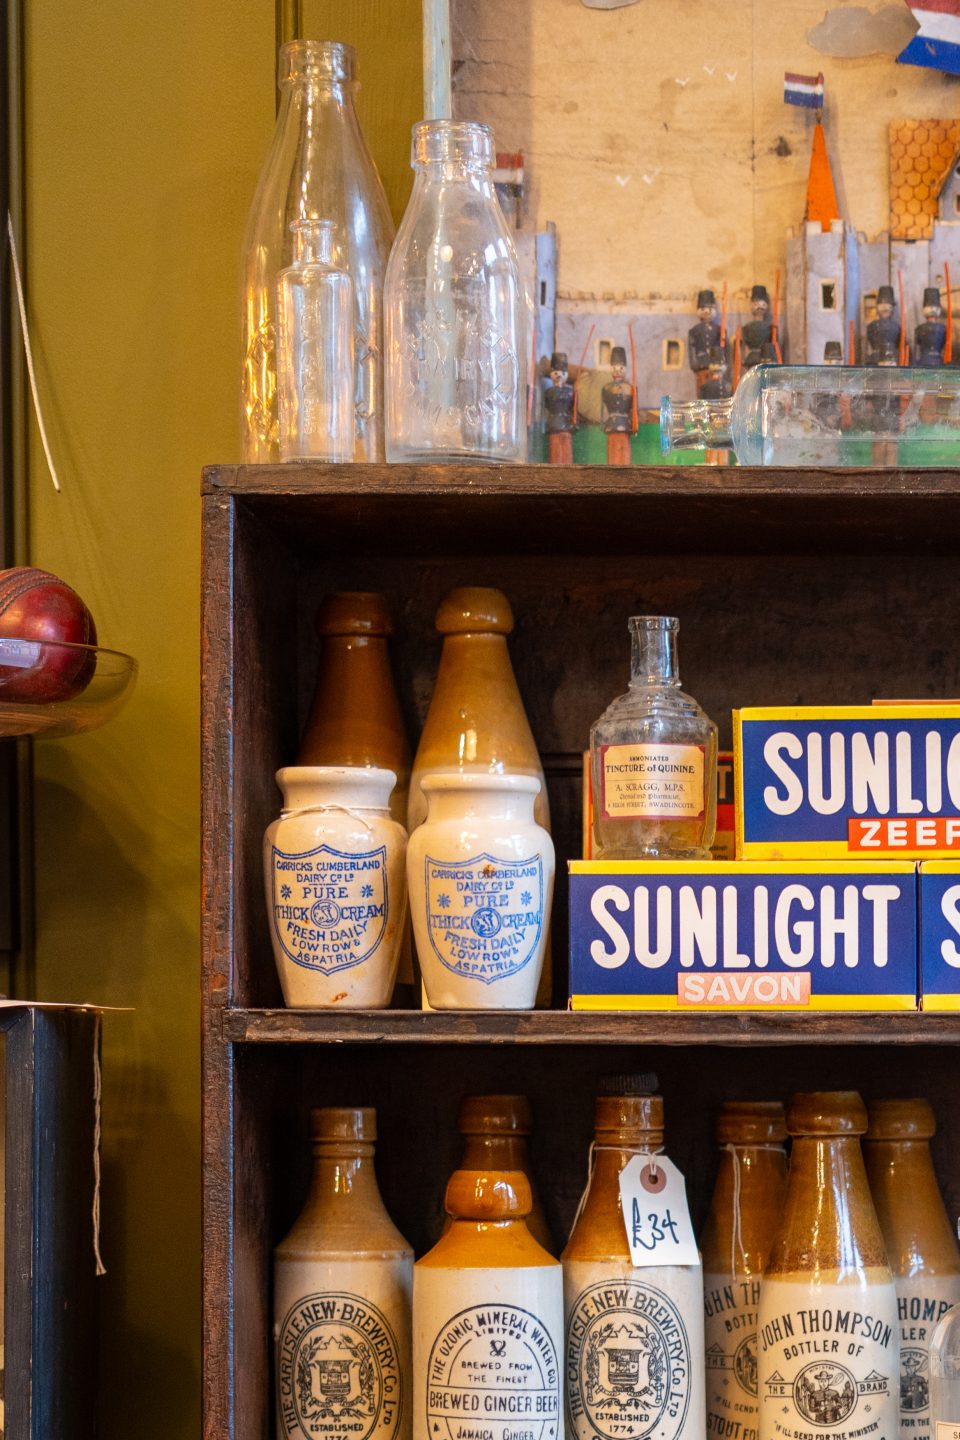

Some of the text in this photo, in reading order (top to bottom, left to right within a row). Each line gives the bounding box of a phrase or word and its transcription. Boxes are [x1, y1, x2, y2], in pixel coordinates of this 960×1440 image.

[606, 764, 644, 773] TINCTURE
[658, 765, 694, 774] QUININE
[277, 860, 380, 871] CARRICKS CUMBERLAND
[297, 874, 327, 882] DAIRY
[432, 870, 473, 880] CARRICKS
[303, 887, 348, 898] PURE
[457, 882, 488, 891] DAIRY
[464, 895, 509, 907] PURE
[275, 904, 384, 921] THICK CREAM
[431, 911, 540, 930] THICK CREAM
[589, 884, 901, 970] SUNLIGHT
[287, 920, 367, 941] FRESH DAILY
[292, 938, 319, 951] LOW
[323, 942, 351, 952] ROW
[444, 928, 525, 950] FRESH DAILY
[297, 951, 356, 964] ASPATRIA
[450, 947, 510, 961] LOW ROW
[454, 960, 517, 973] ASPATRIA
[683, 973, 802, 1001] SAVON
[632, 1197, 680, 1250] £34
[568, 1305, 593, 1381] CARLISLE
[592, 1289, 629, 1312] NEW
[633, 1290, 685, 1364] BREWERY
[762, 1313, 795, 1352] JOHN
[797, 1310, 892, 1348] THOMPSON
[281, 1318, 305, 1395] CARLISLE
[301, 1301, 338, 1326] NEW
[341, 1303, 396, 1371] BREWERY
[432, 1358, 446, 1381] THE
[476, 1311, 528, 1333] MINERAL
[530, 1328, 553, 1366] WATER
[784, 1340, 864, 1360] BOTTLER OF
[461, 1361, 532, 1370] BREWED FROM
[707, 1357, 726, 1368] THE
[468, 1375, 528, 1384] THE FINEST
[768, 1382, 888, 1394] THE BRAND
[429, 1390, 558, 1413] BREWED GINGER BEER
[595, 1412, 650, 1422] ESTABLISHED
[310, 1424, 364, 1432] ESTABLISHED
[609, 1425, 635, 1434] 1774
[707, 1412, 740, 1439] STOUT
[457, 1426, 494, 1440] JAMAICA
[793, 1431, 813, 1440] SEND
[832, 1432, 847, 1440] THE
